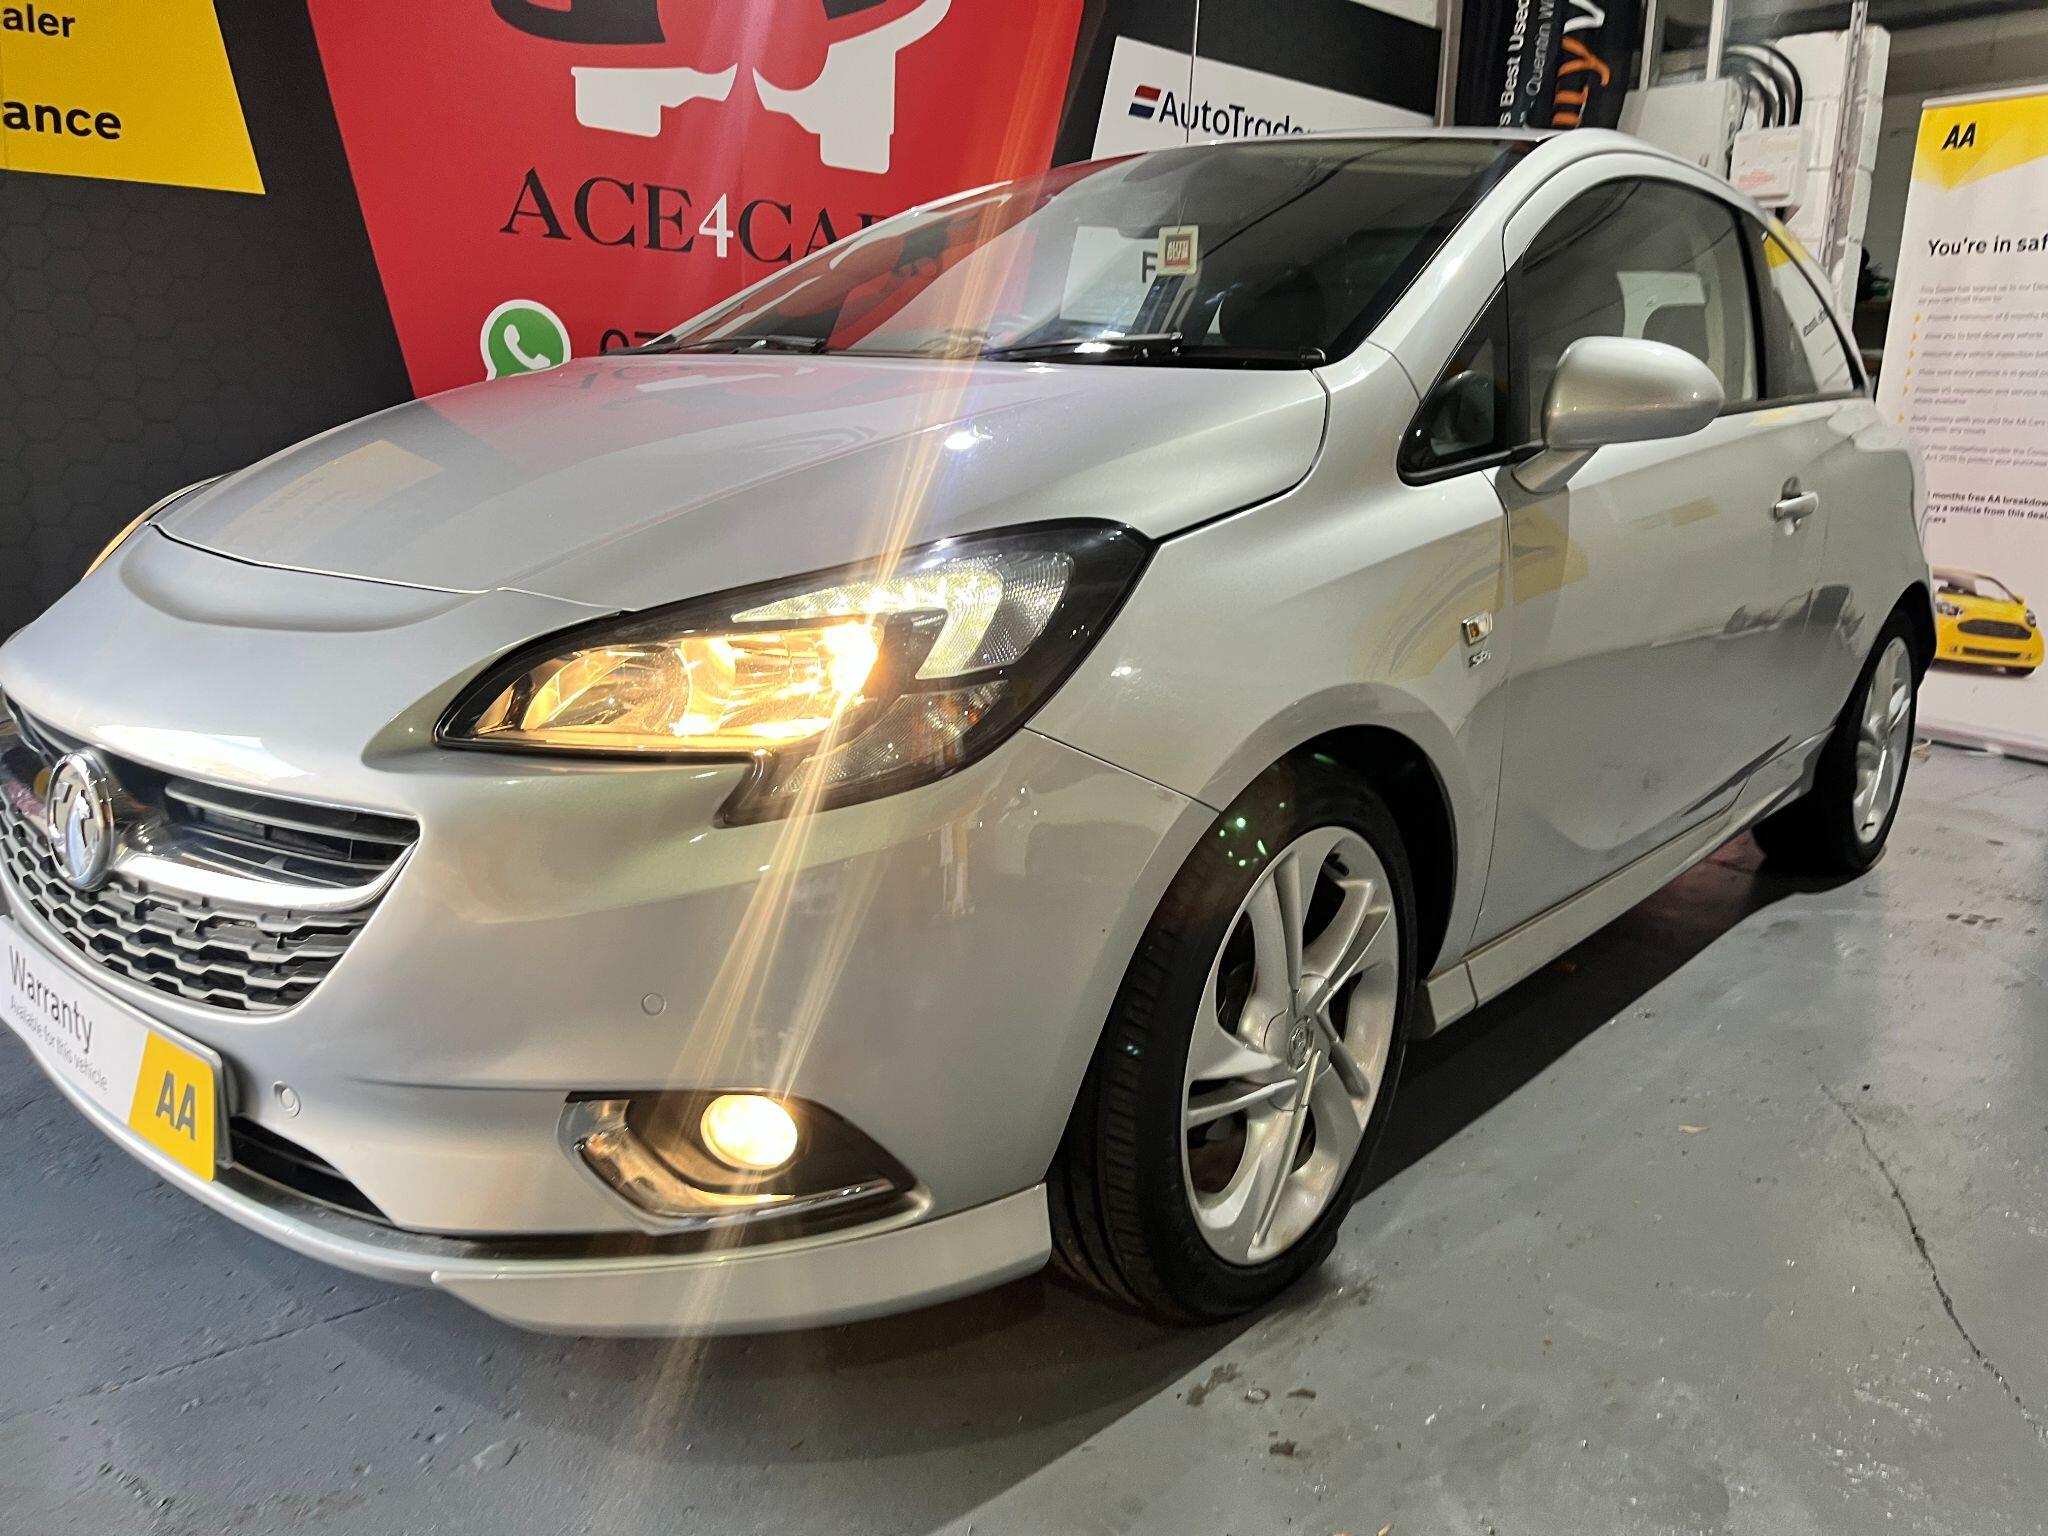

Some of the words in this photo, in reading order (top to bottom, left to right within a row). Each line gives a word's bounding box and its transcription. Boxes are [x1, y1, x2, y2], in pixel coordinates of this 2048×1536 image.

[3, 4, 76, 38] aler
[1500, 55, 1521, 107] Best
[3, 101, 121, 140] ance
[1940, 122, 1977, 150] AA
[1928, 236, 1987, 257] You're
[1993, 234, 2011, 254] in
[1950, 505, 1982, 514] vehicle
[1983, 506, 2005, 516] from
[1967, 492, 1986, 502] free
[1987, 494, 2001, 504] AA
[9, 945, 93, 1055] Warranty
[155, 1070, 196, 1142] AA
